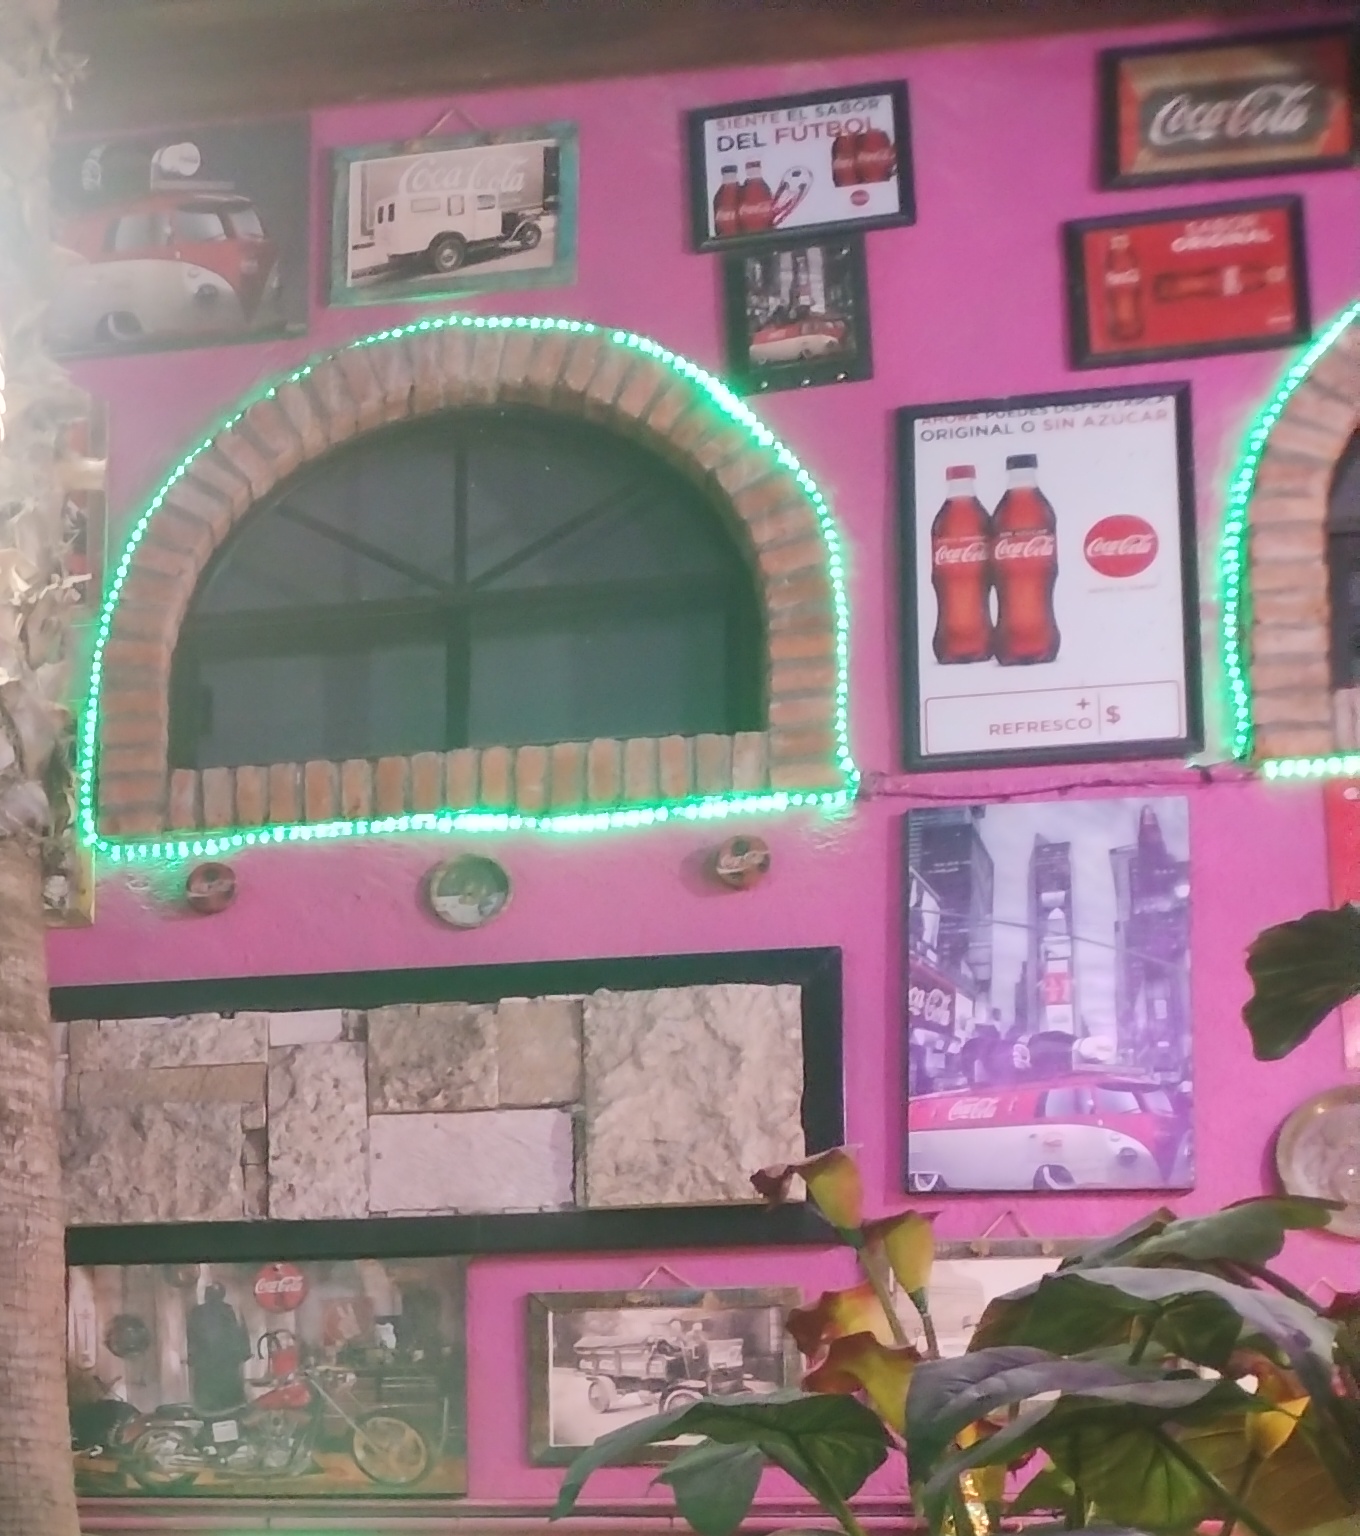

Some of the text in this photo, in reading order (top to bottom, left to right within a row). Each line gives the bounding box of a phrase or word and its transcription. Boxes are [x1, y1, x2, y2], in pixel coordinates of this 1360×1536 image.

[715, 98, 880, 131] SIENTE EL SABOR
[716, 131, 767, 152] DEL
[920, 422, 1014, 442] ORIGINAL
[1020, 420, 1036, 434] O
[1042, 416, 1075, 432] SIN
[989, 717, 1093, 736] REFRESCO
